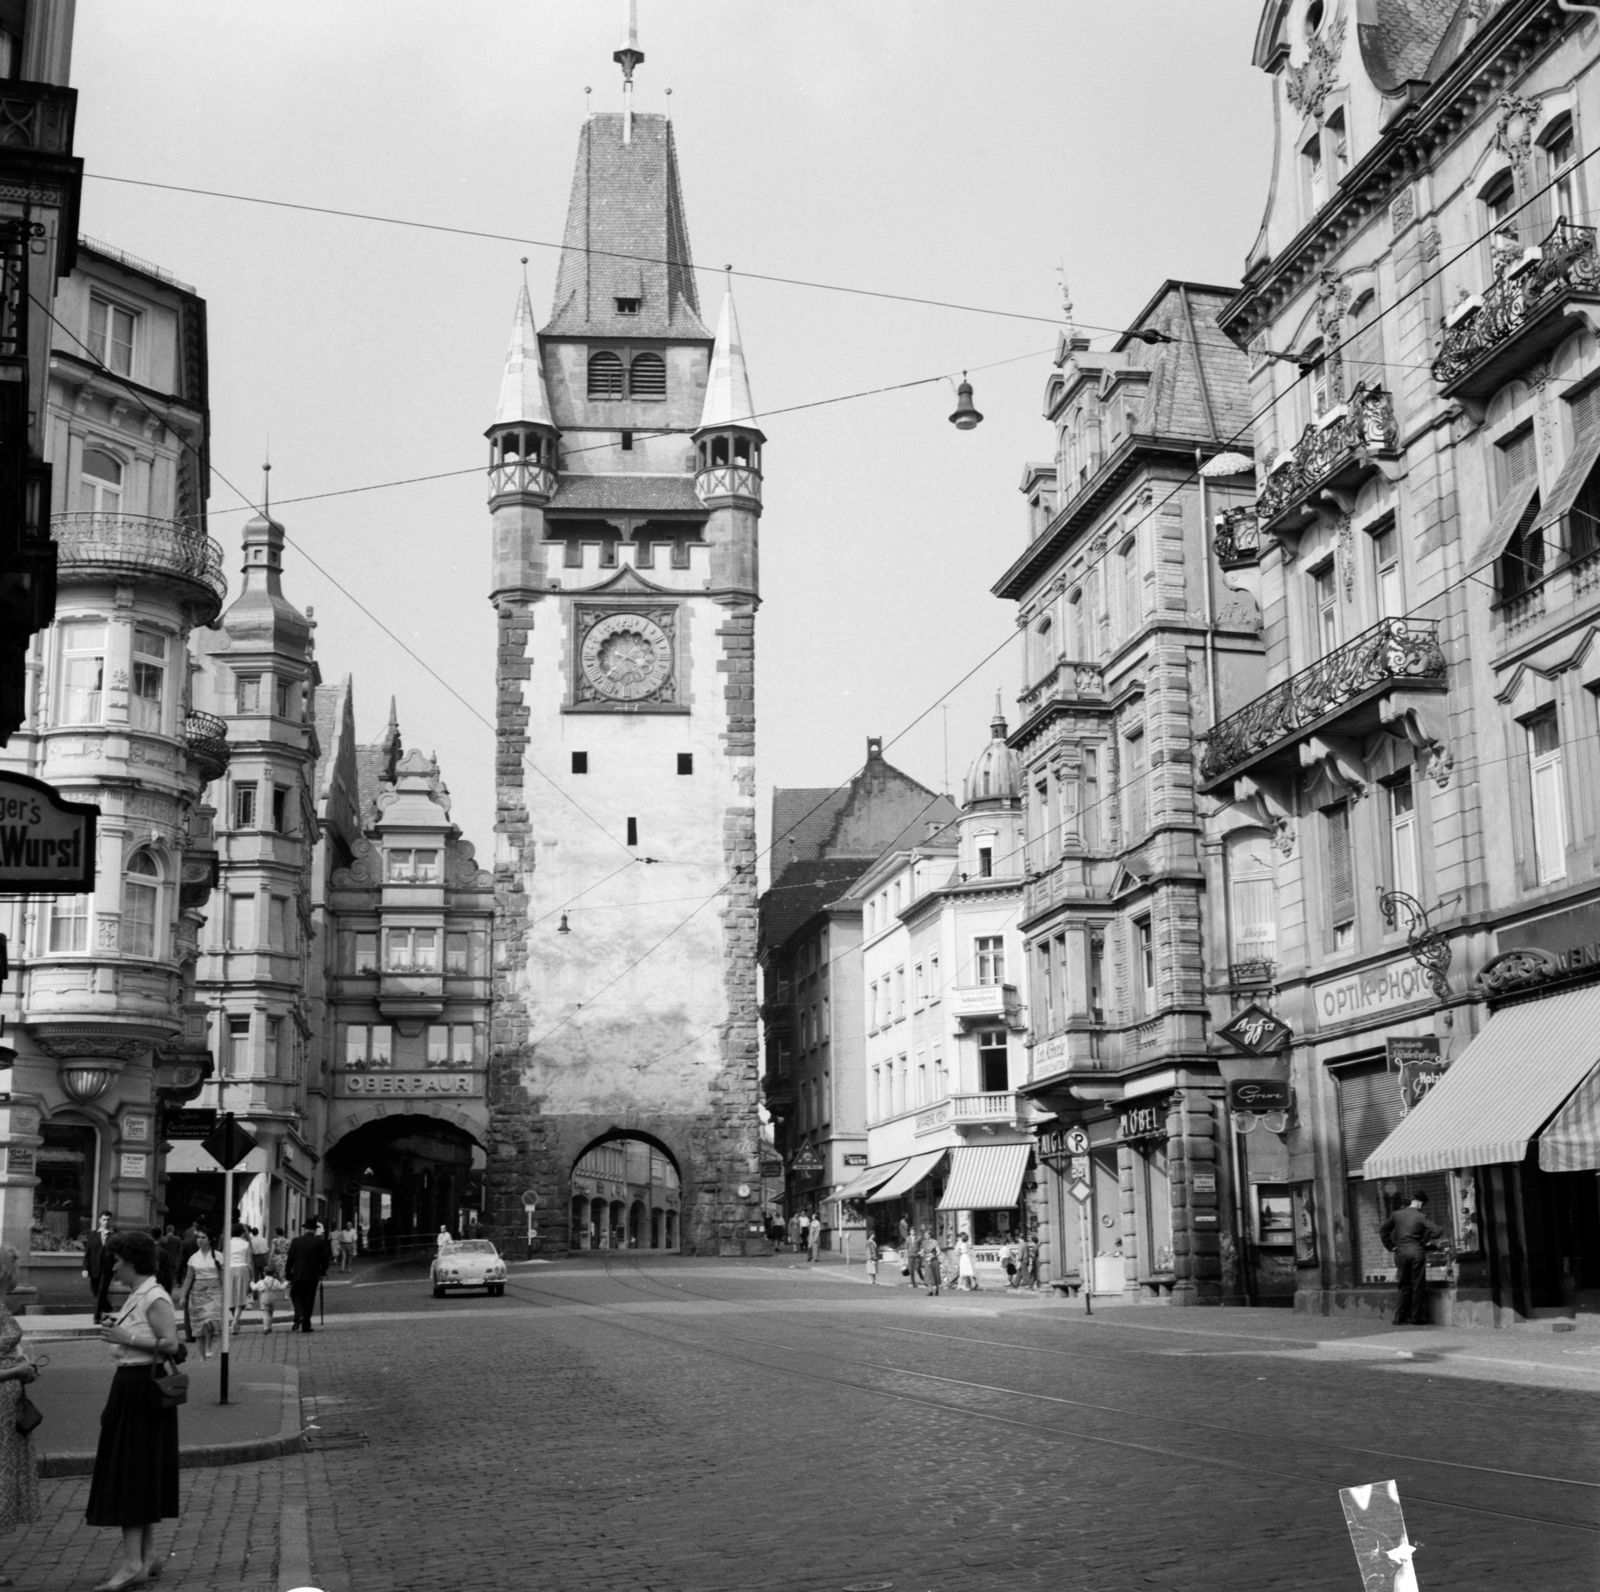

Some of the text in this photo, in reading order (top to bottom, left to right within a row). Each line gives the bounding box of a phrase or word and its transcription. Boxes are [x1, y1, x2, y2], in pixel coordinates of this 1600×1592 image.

[1230, 1017, 1275, 1045] Agfa
[347, 1076, 469, 1092] OBERPAUR
[1120, 1107, 1158, 1135] MÖBEL
